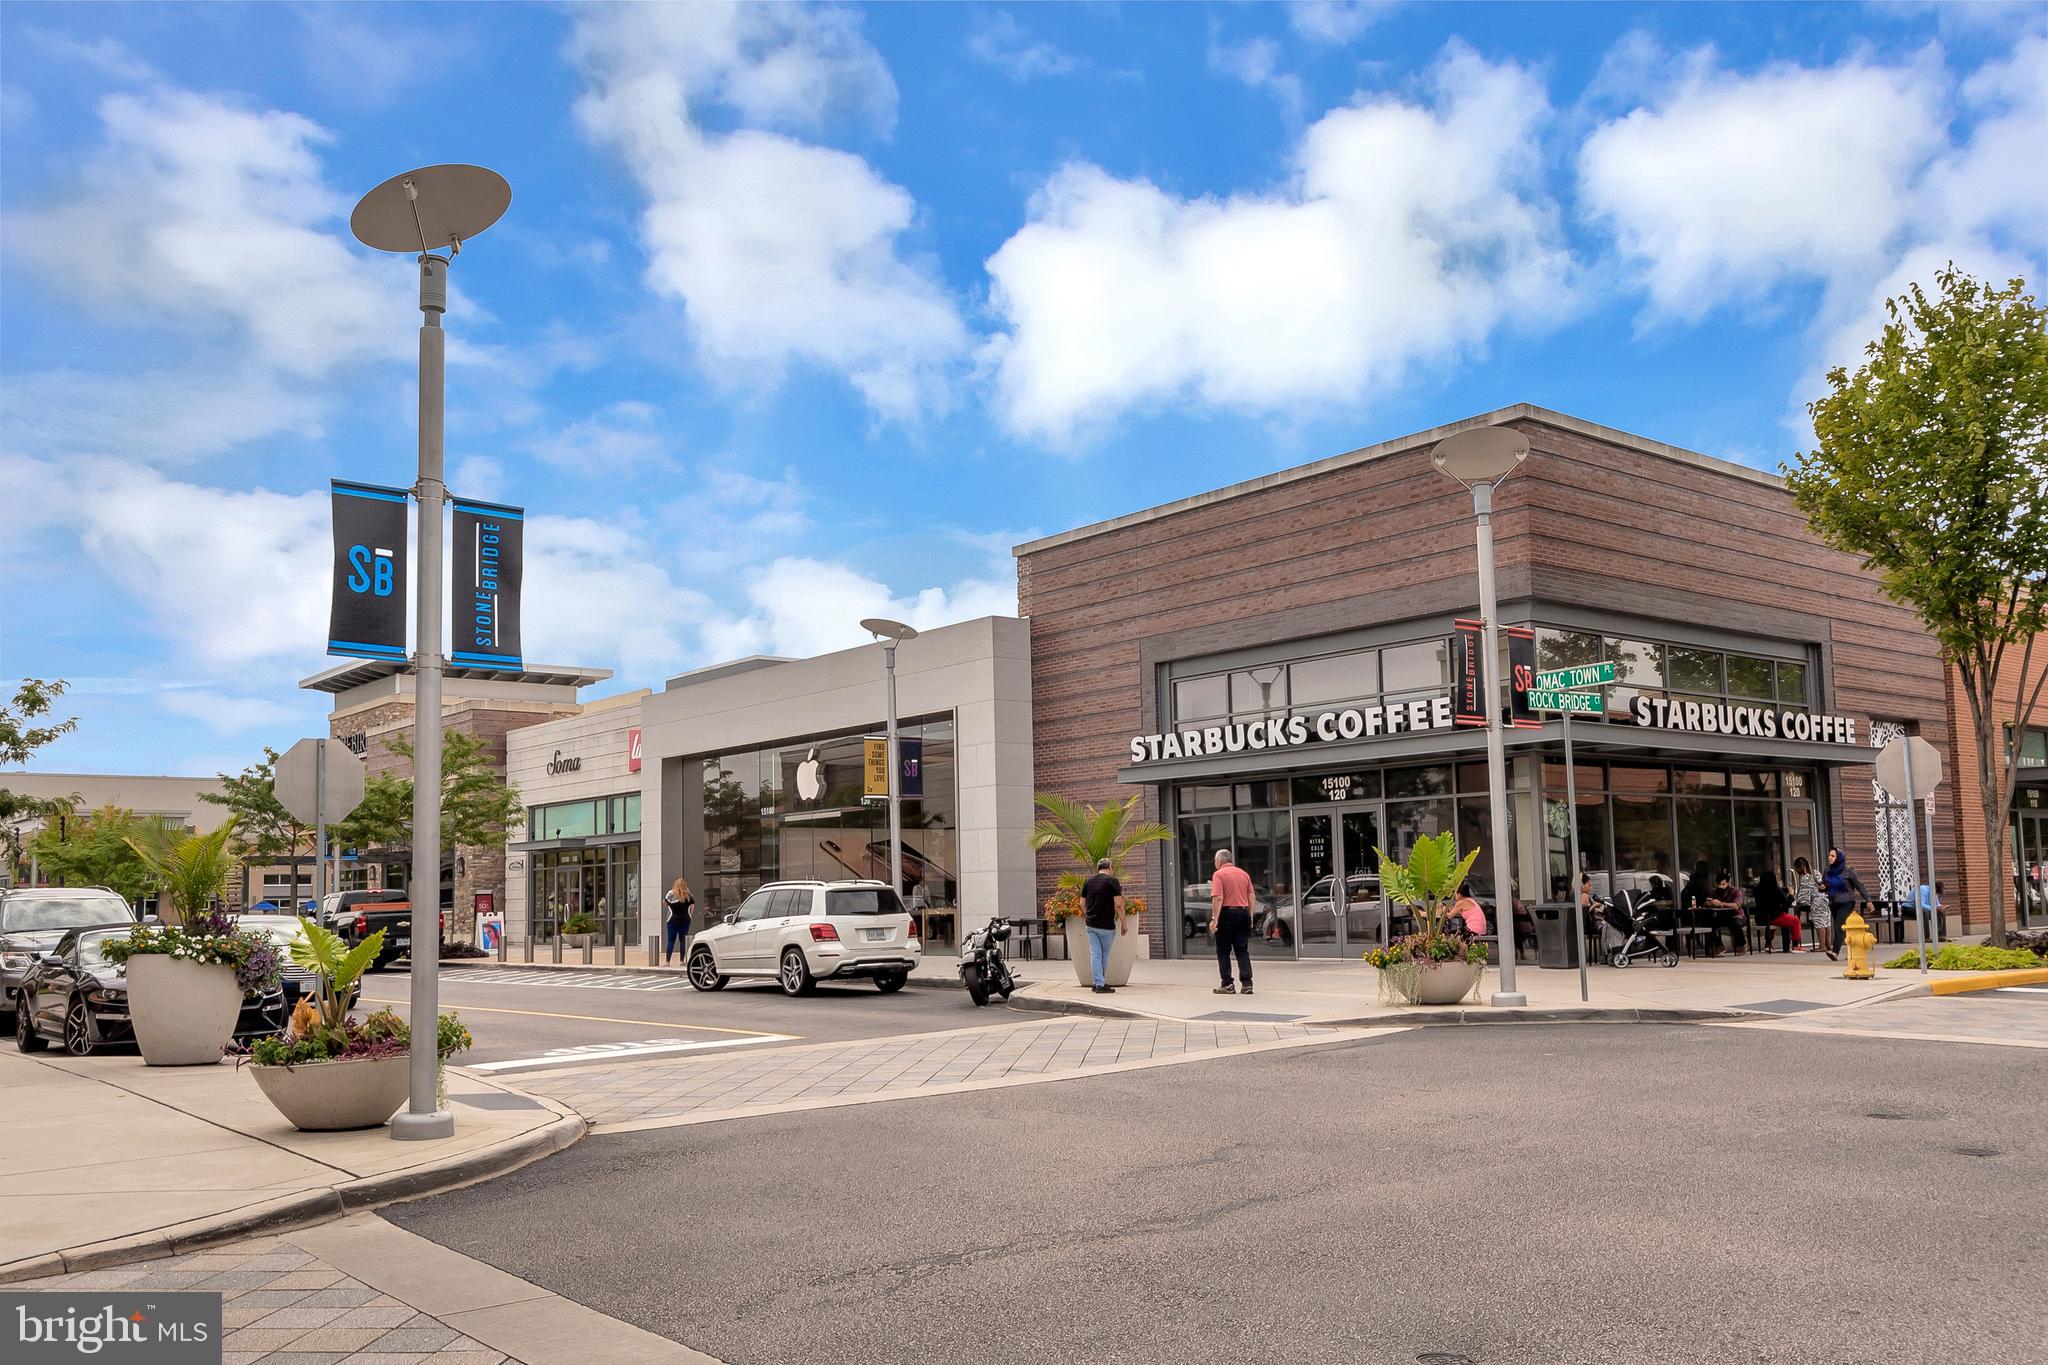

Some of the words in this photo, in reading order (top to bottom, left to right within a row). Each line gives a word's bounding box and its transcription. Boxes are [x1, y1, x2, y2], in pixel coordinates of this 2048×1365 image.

[348, 544, 394, 597] SB
[1536, 672, 1566, 690] OMAC
[1570, 666, 1600, 686] TOWN
[1604, 664, 1612, 673] PL
[1529, 691, 1555, 708] ROCK
[1558, 694, 1591, 711] BRIDGE
[1130, 716, 1308, 763] STARBUCKS
[1316, 697, 1453, 742] COFFEE
[1636, 696, 1777, 738] STARBUCKS
[1781, 711, 1856, 744] COFFEE
[546, 749, 582, 776] Soma
[1322, 776, 1351, 789] 15100
[1328, 788, 1346, 800] 120
